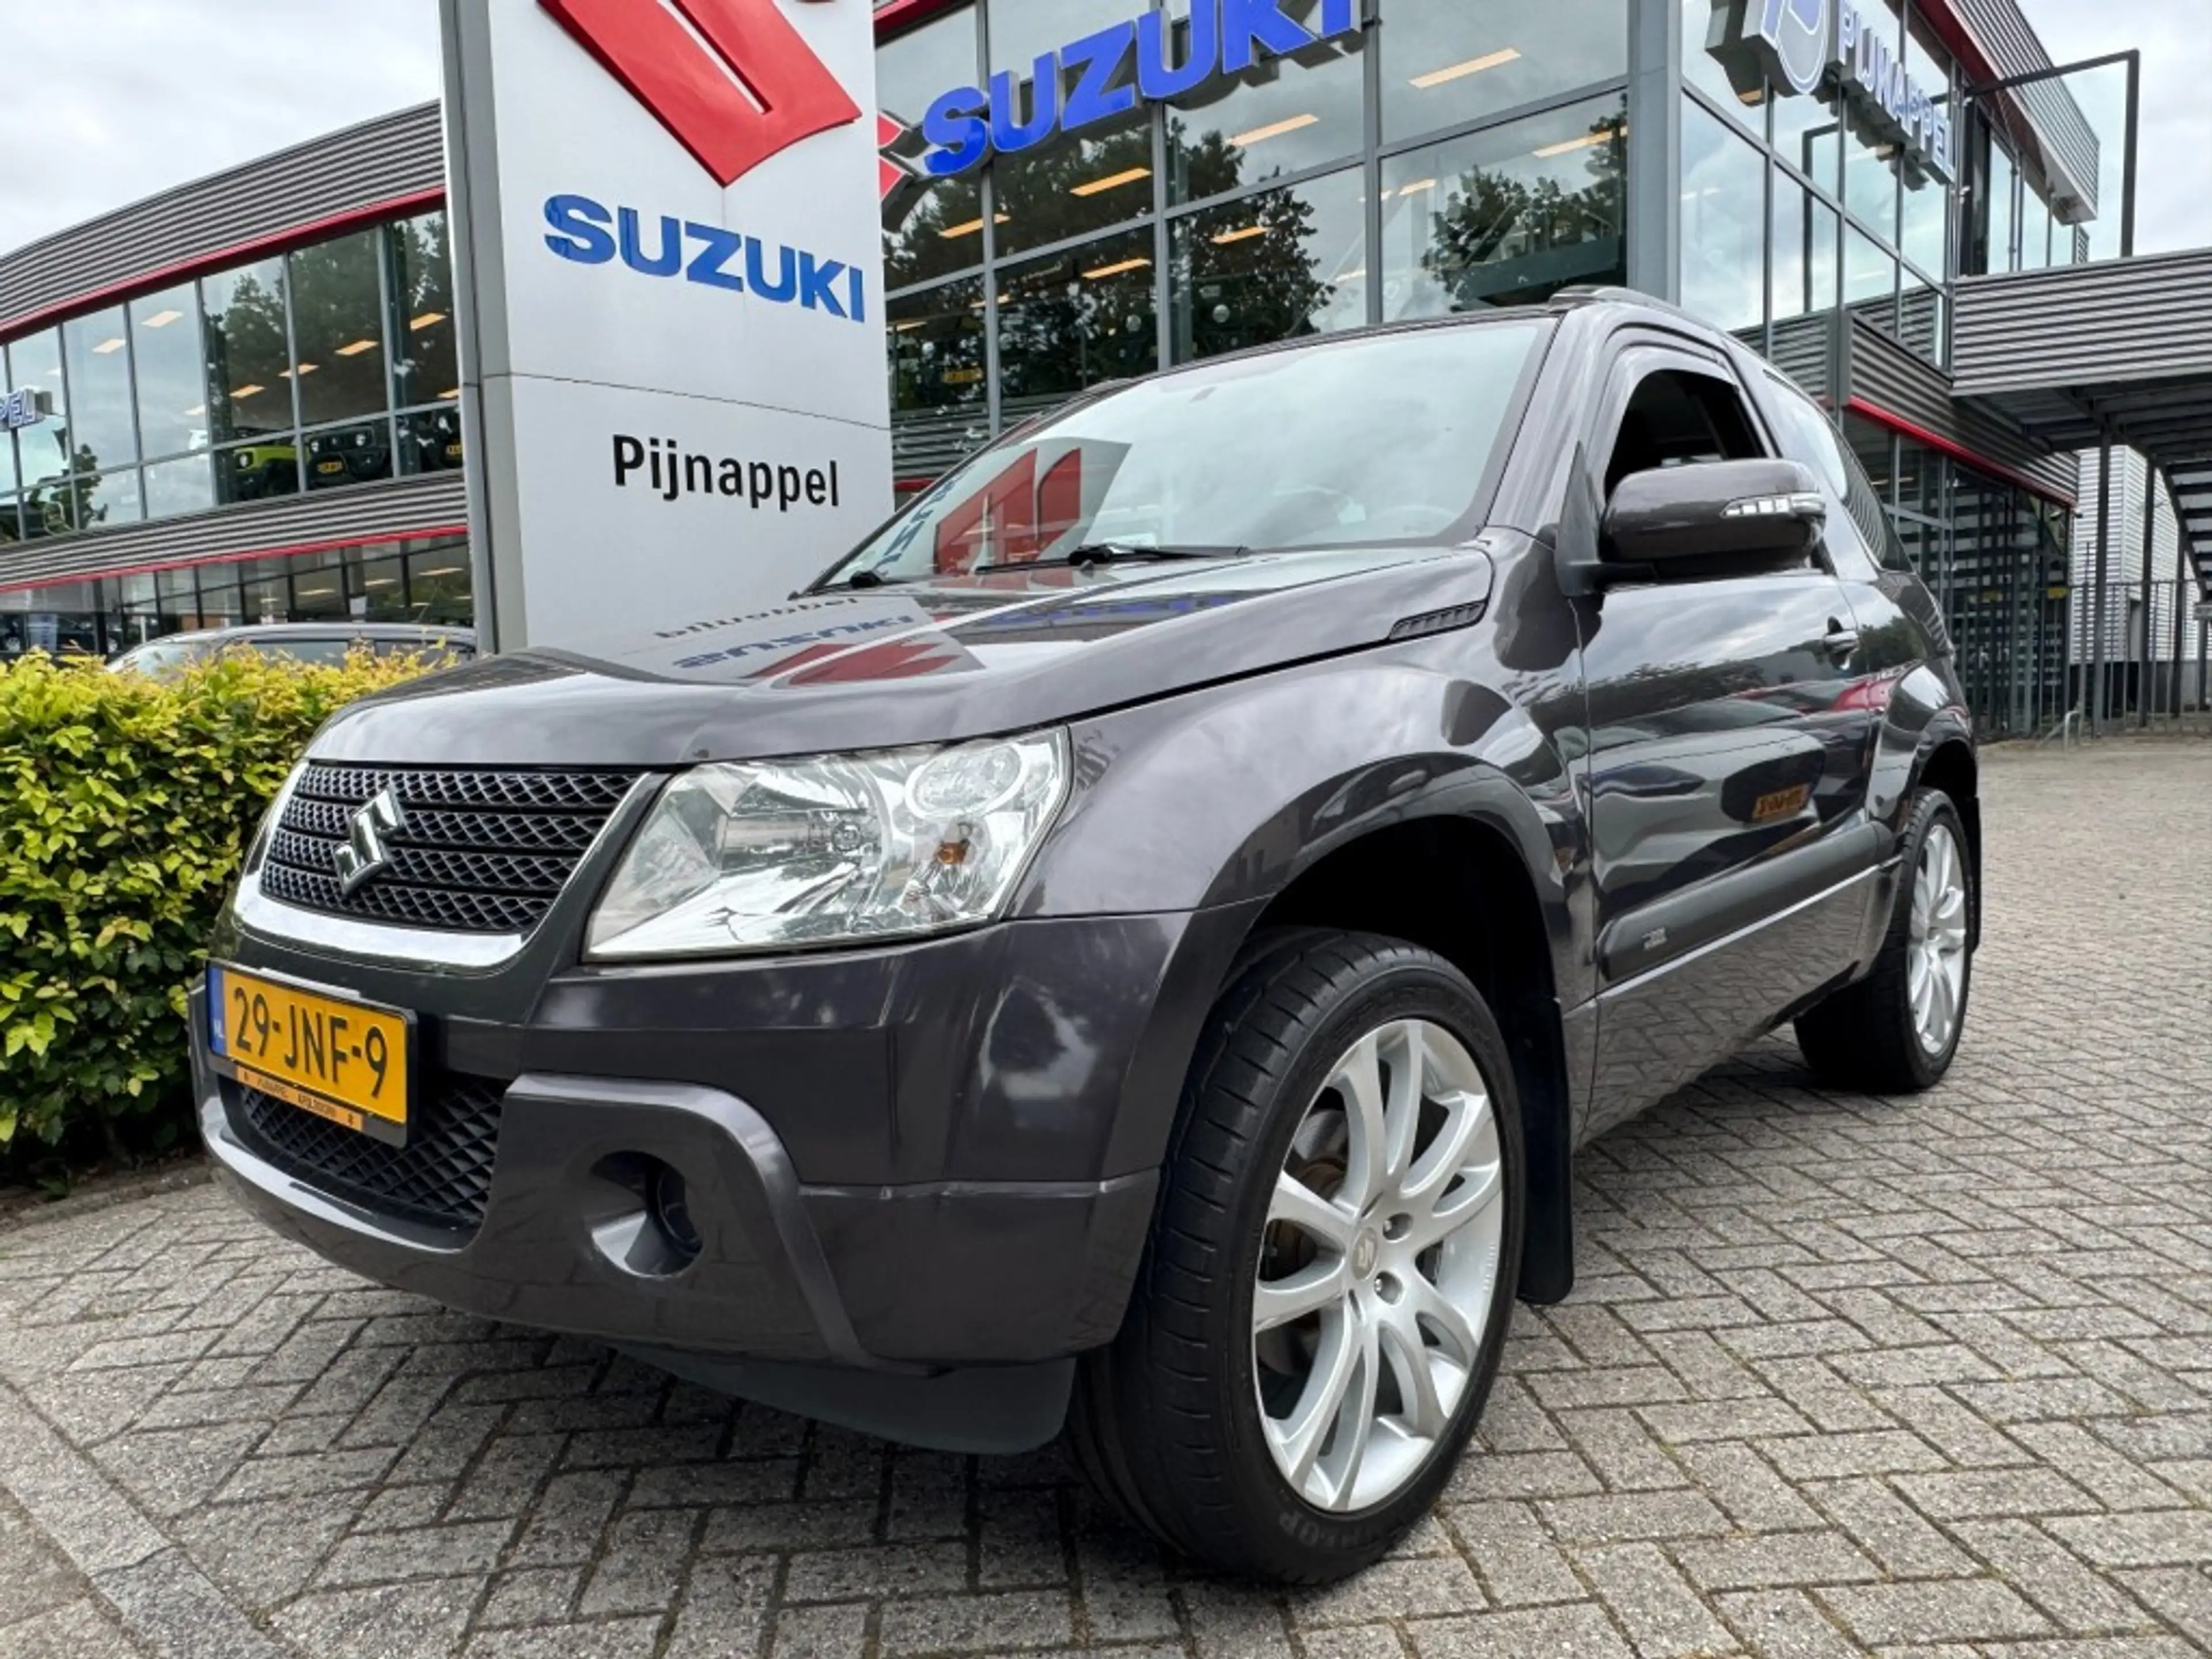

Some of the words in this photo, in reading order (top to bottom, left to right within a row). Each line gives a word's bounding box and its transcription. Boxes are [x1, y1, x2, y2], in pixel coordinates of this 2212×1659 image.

[544, 195, 865, 323] SUZUKI
[613, 434, 839, 512] Pijnappel
[234, 987, 388, 1099] 29-JNF-9
